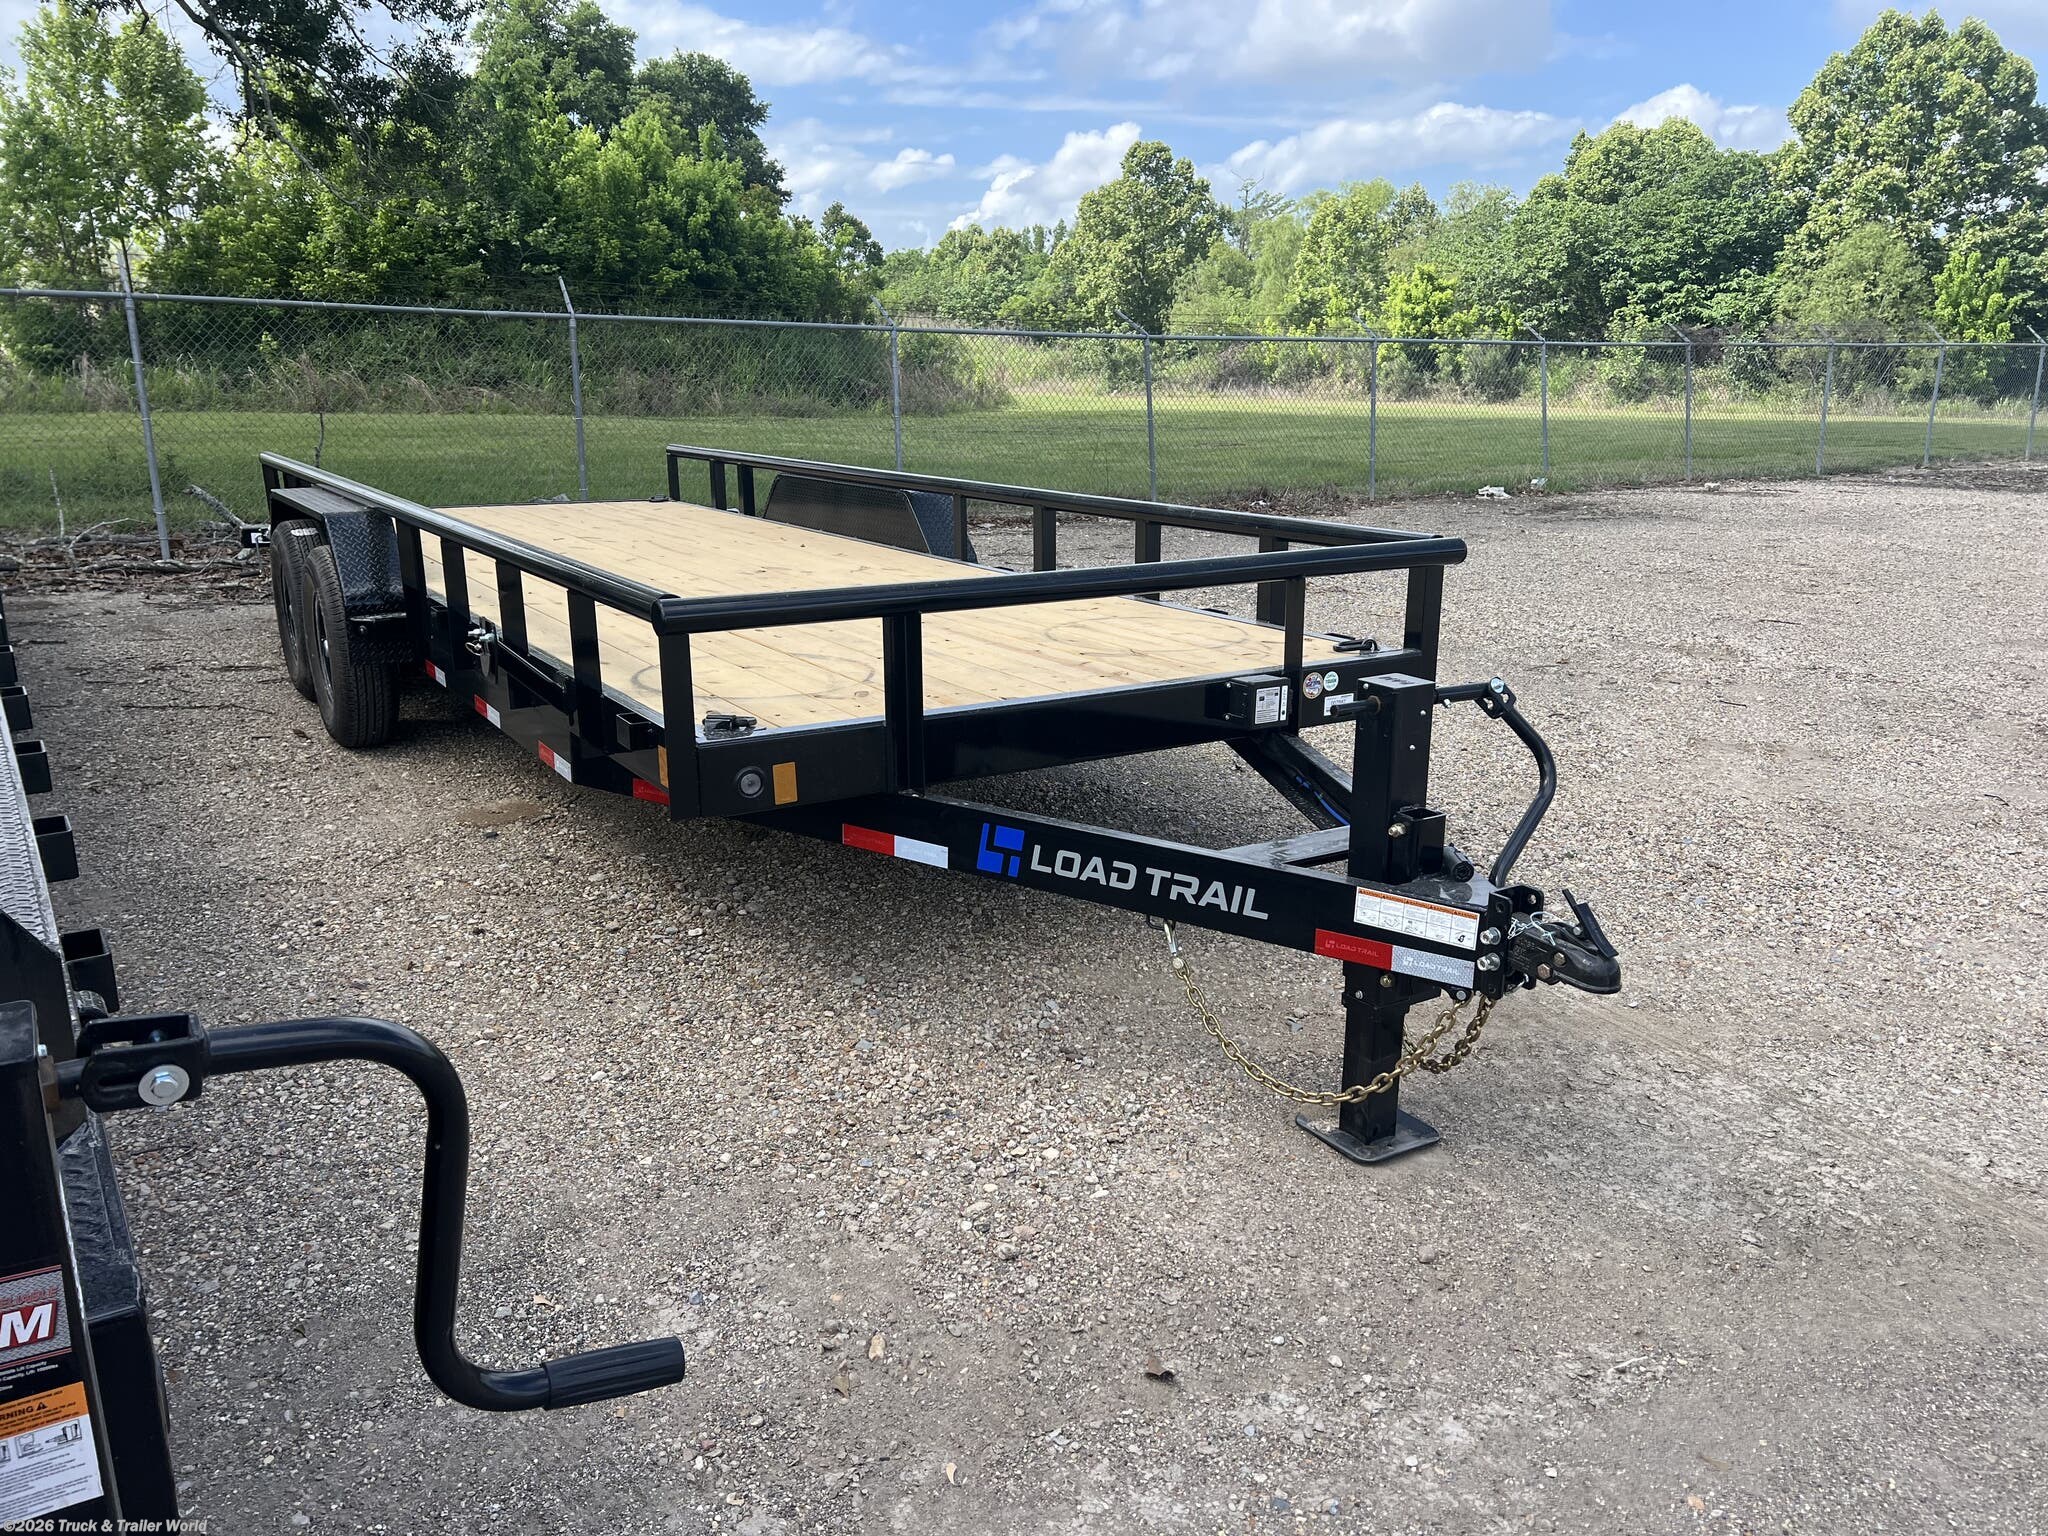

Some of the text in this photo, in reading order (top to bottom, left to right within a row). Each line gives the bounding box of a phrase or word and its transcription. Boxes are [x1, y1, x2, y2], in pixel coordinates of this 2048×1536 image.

[1030, 844, 1269, 920] LOAD TRAIL
[1335, 943, 1379, 958] LOAD TRAIL
